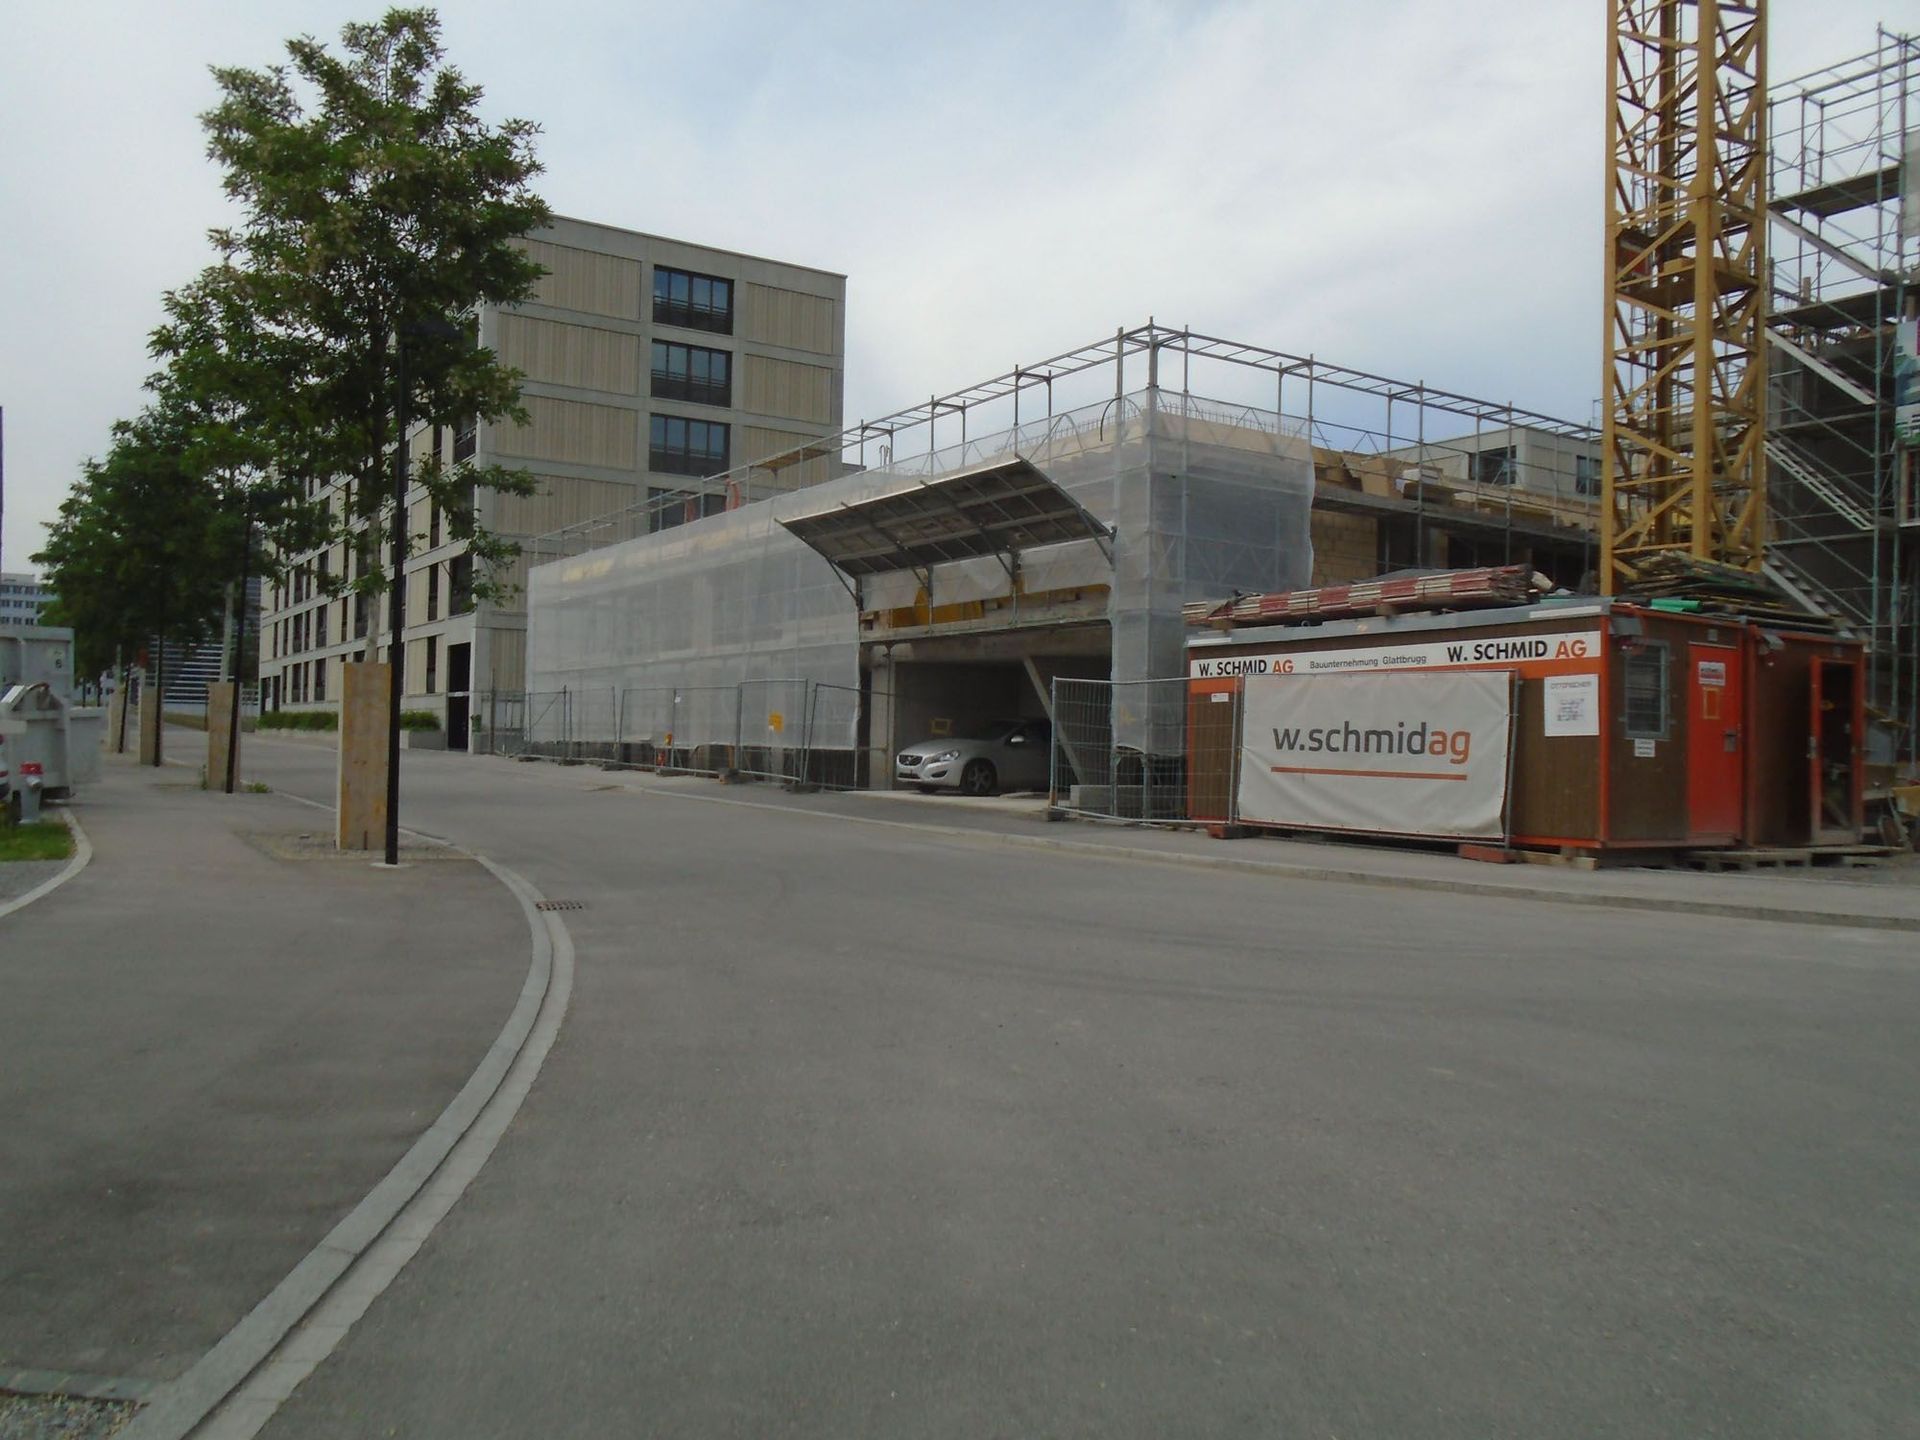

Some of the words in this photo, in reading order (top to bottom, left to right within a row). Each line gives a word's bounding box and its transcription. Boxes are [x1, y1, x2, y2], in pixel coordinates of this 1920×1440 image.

[1447, 645, 1468, 662] W.
[1473, 640, 1548, 660] SCHMID
[1555, 639, 1587, 658] AG
[1198, 662, 1213, 676] W.
[1216, 659, 1267, 675] SCHMID
[1272, 659, 1294, 673] AG
[1309, 657, 1379, 669] Bauunternehmung
[1382, 655, 1427, 665] Glattbrugg
[1272, 720, 1471, 765] w.schmidag
